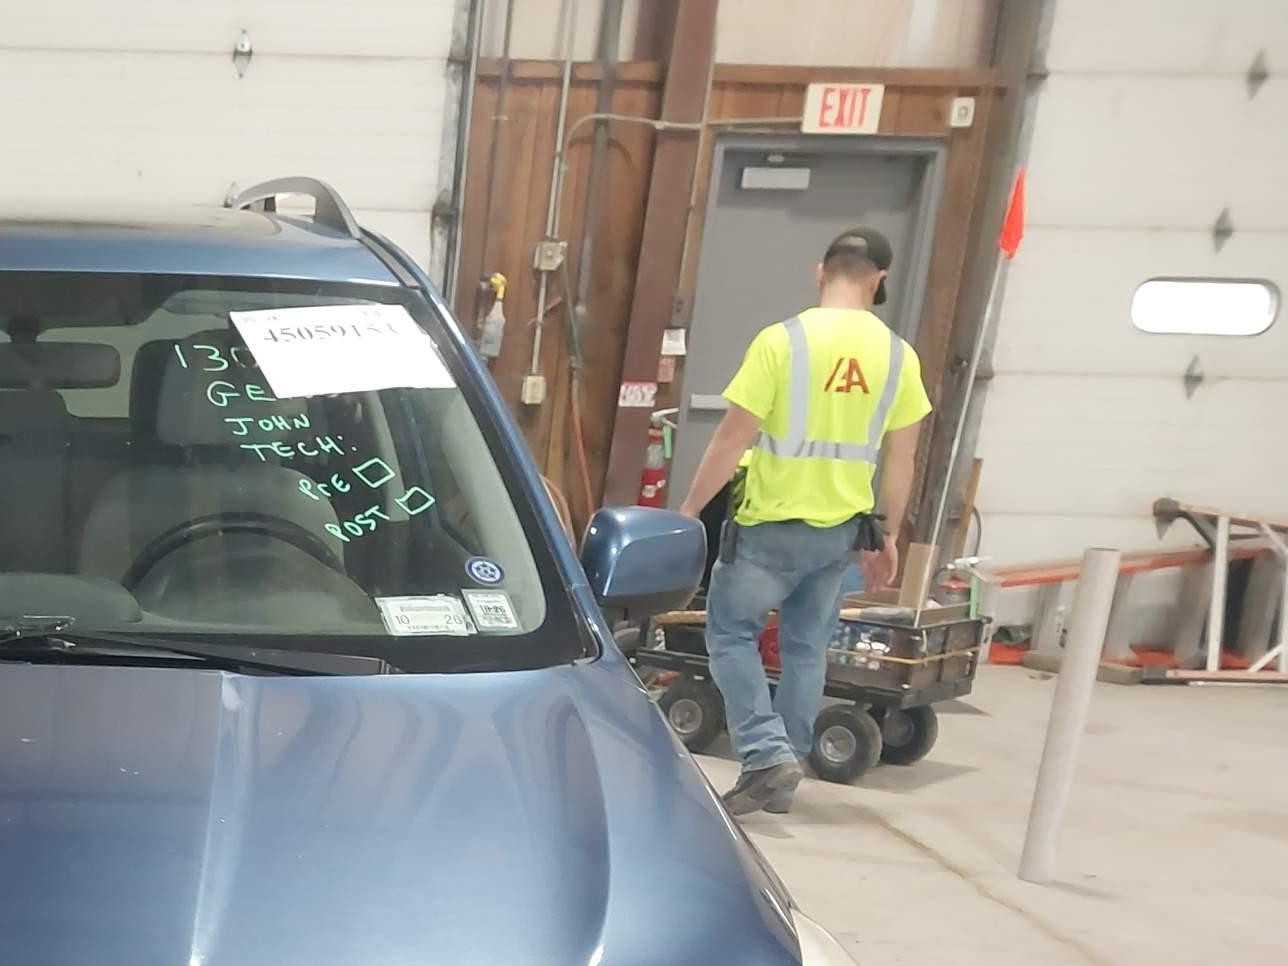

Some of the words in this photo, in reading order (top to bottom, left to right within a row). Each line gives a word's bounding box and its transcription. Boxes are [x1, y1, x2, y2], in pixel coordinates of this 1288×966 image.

[818, 87, 871, 128] EXIT
[224, 414, 310, 435] JOHN
[325, 505, 390, 542] POST
[395, 615, 410, 625] 10
